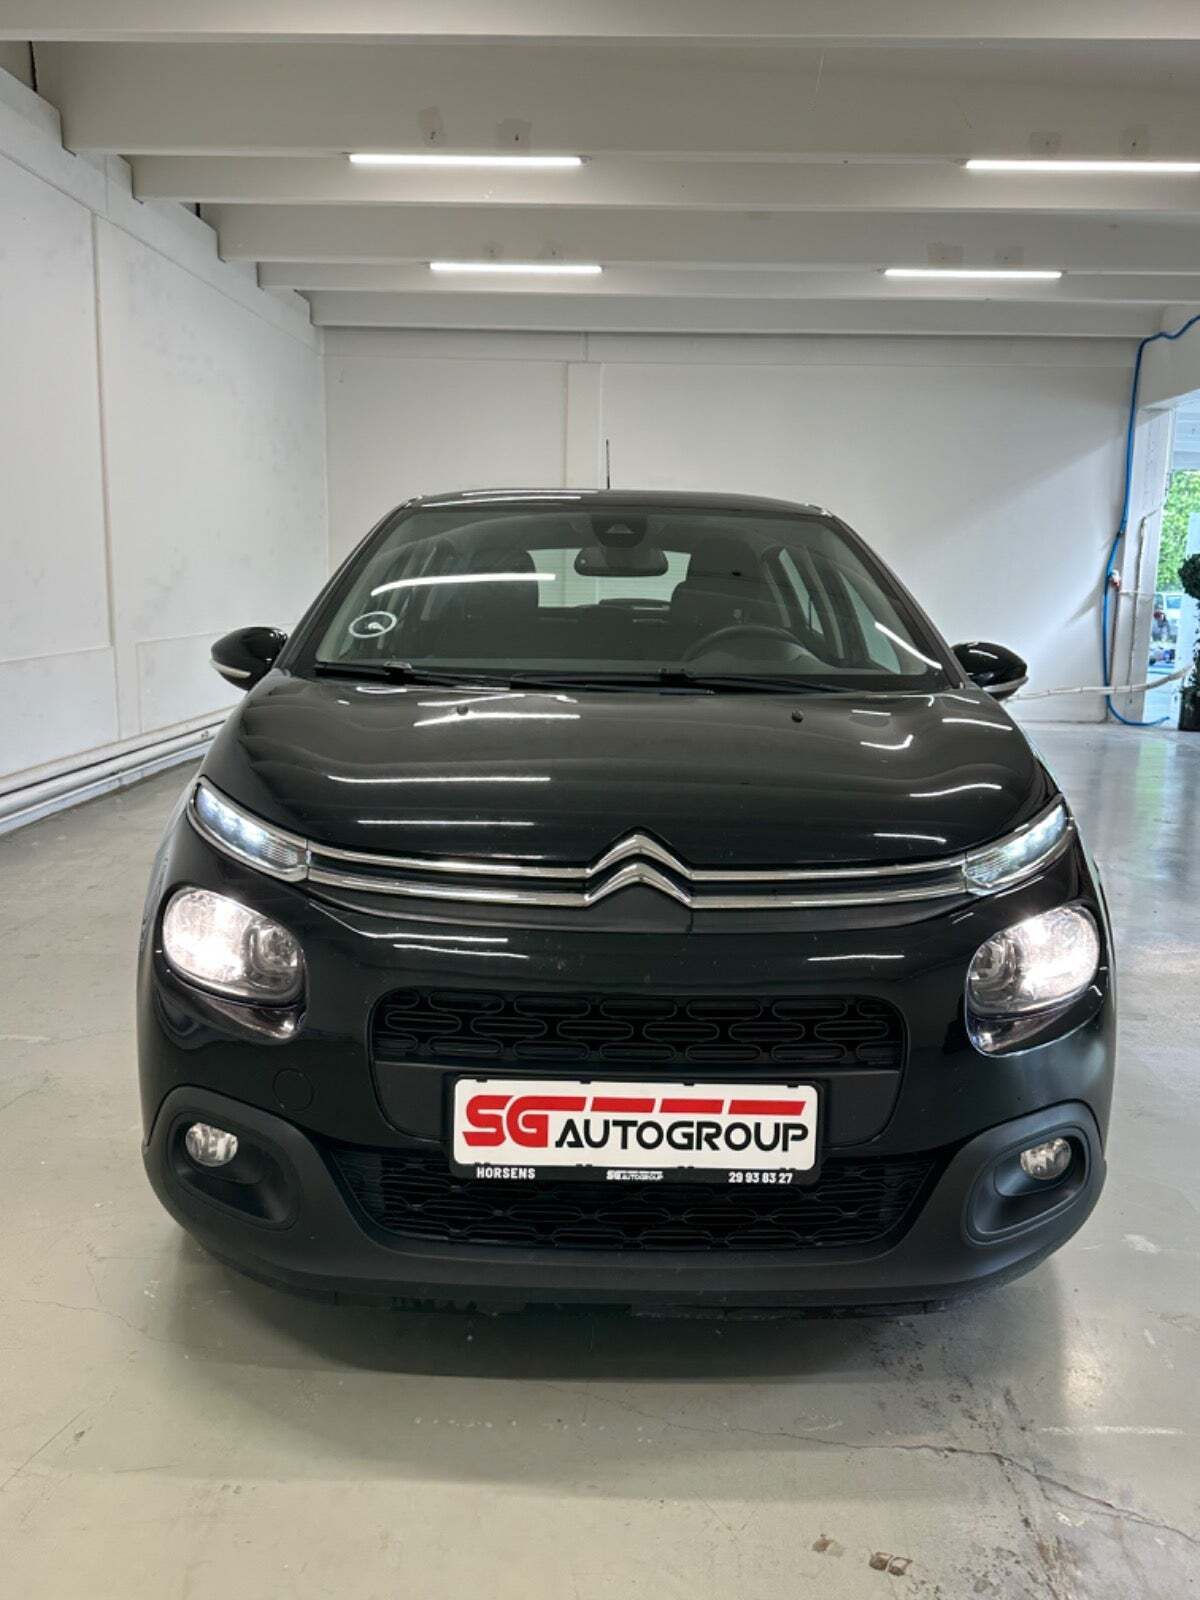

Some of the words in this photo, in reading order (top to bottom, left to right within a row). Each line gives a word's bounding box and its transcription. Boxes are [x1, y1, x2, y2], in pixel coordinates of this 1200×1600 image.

[462, 1095, 587, 1148] SG
[555, 1118, 809, 1152] AUTOGROUP
[476, 1166, 536, 1180] HORSENS
[778, 1172, 793, 1184] 27
